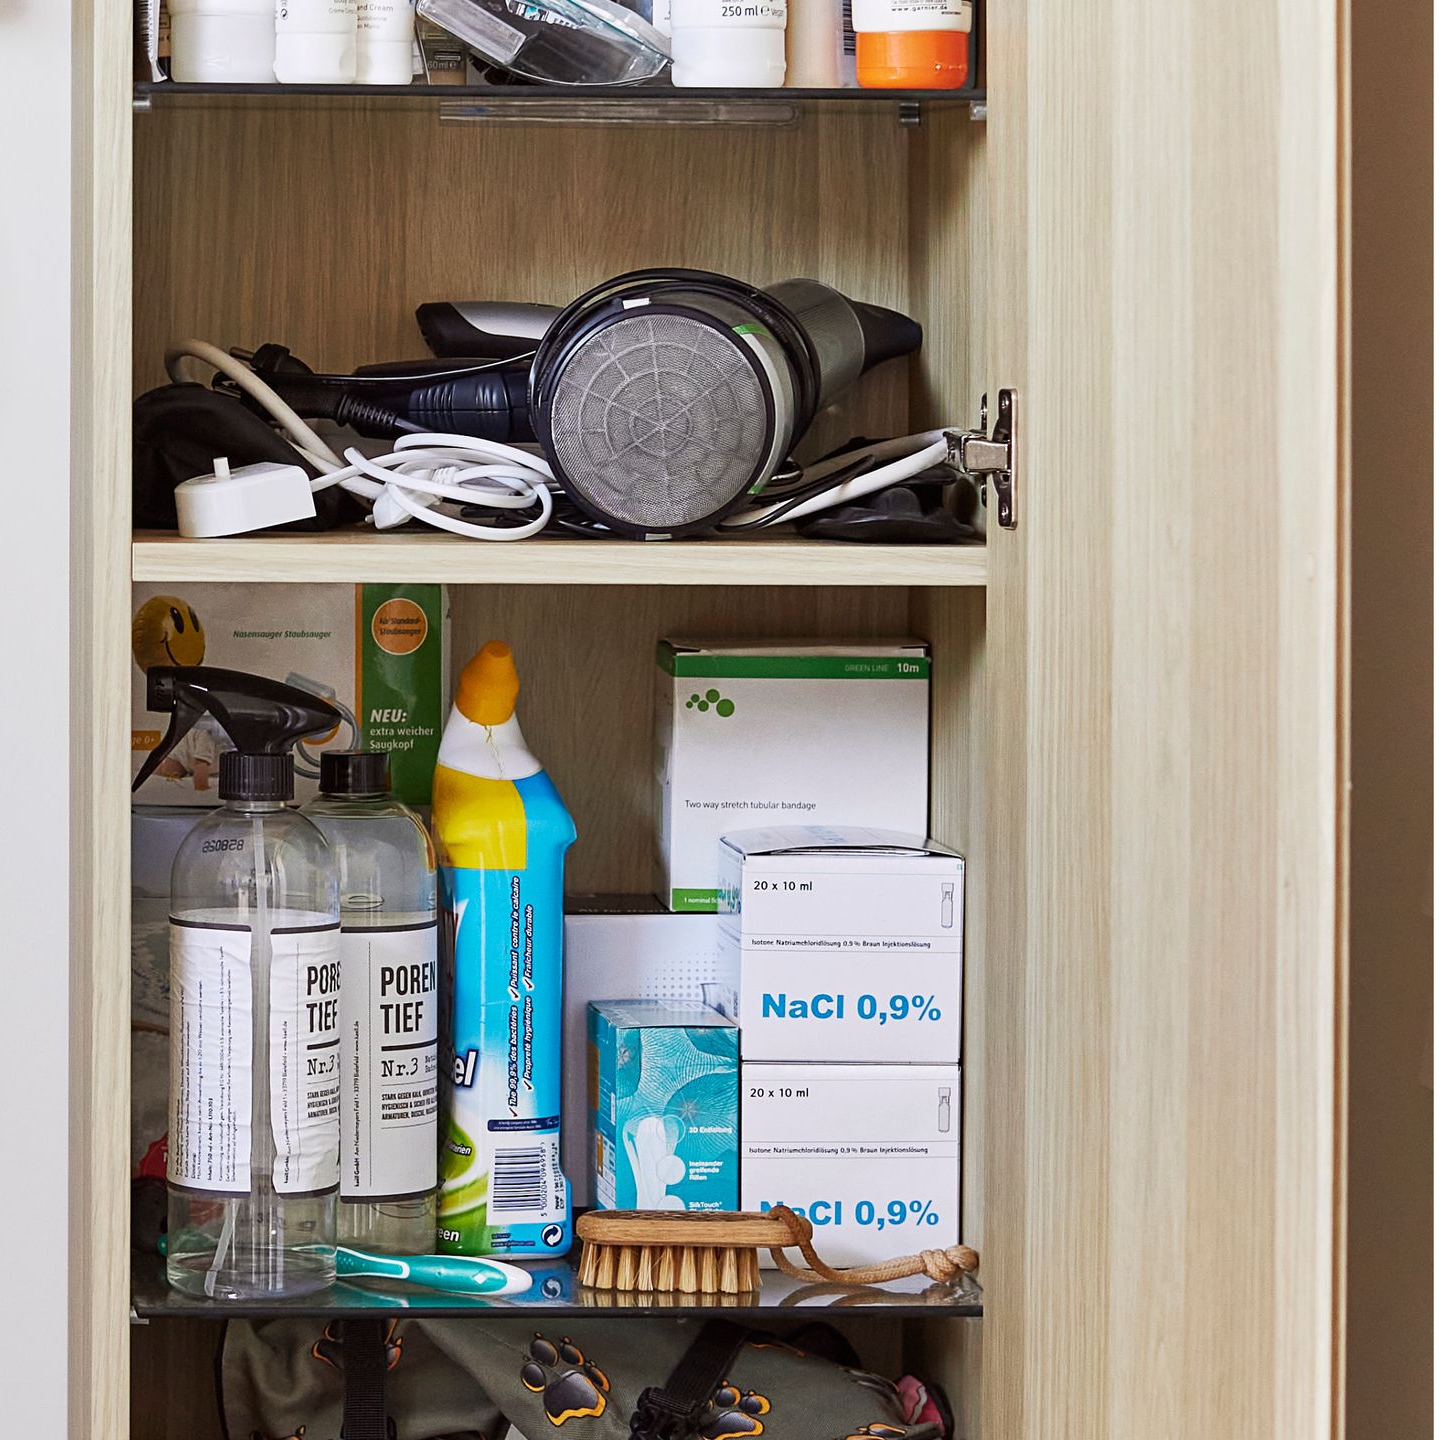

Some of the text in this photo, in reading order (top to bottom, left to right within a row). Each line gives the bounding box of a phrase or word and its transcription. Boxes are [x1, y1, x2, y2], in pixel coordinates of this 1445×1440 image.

[722, 6, 758, 17] 250 ml
[233, 630, 332, 639] Nasensauger Staubsauger
[845, 664, 889, 672] GREEN LINE
[897, 663, 919, 673] 10m
[370, 709, 407, 723] NEU:
[370, 726, 434, 736] extra weicher
[370, 740, 414, 751] Saugkopf
[685, 800, 816, 811] Two way stretch tubular bandage
[754, 881, 768, 891] 20
[783, 881, 796, 890] 10
[800, 881, 812, 891] ml
[510, 877, 520, 988] Puissant contre le calcaire
[524, 906, 533, 978] Fraîcheur durable
[776, 940, 841, 948] Natriumchloridlösung
[381, 961, 436, 996] POREN
[306, 999, 337, 1032] TIEF
[380, 1001, 423, 1034] TIEF
[762, 994, 941, 1025] NaCl 0,9%
[524, 996, 533, 1079] Propreté hygiénique
[509, 1005, 518, 1106] Tue 99,9% des bactéries
[307, 1055, 335, 1076] Nr.3
[381, 1058, 418, 1077] Nr.3
[750, 1088, 764, 1098] 20
[779, 1088, 792, 1098] 10
[796, 1088, 809, 1098] ml
[855, 1200, 939, 1230] 0,9%
